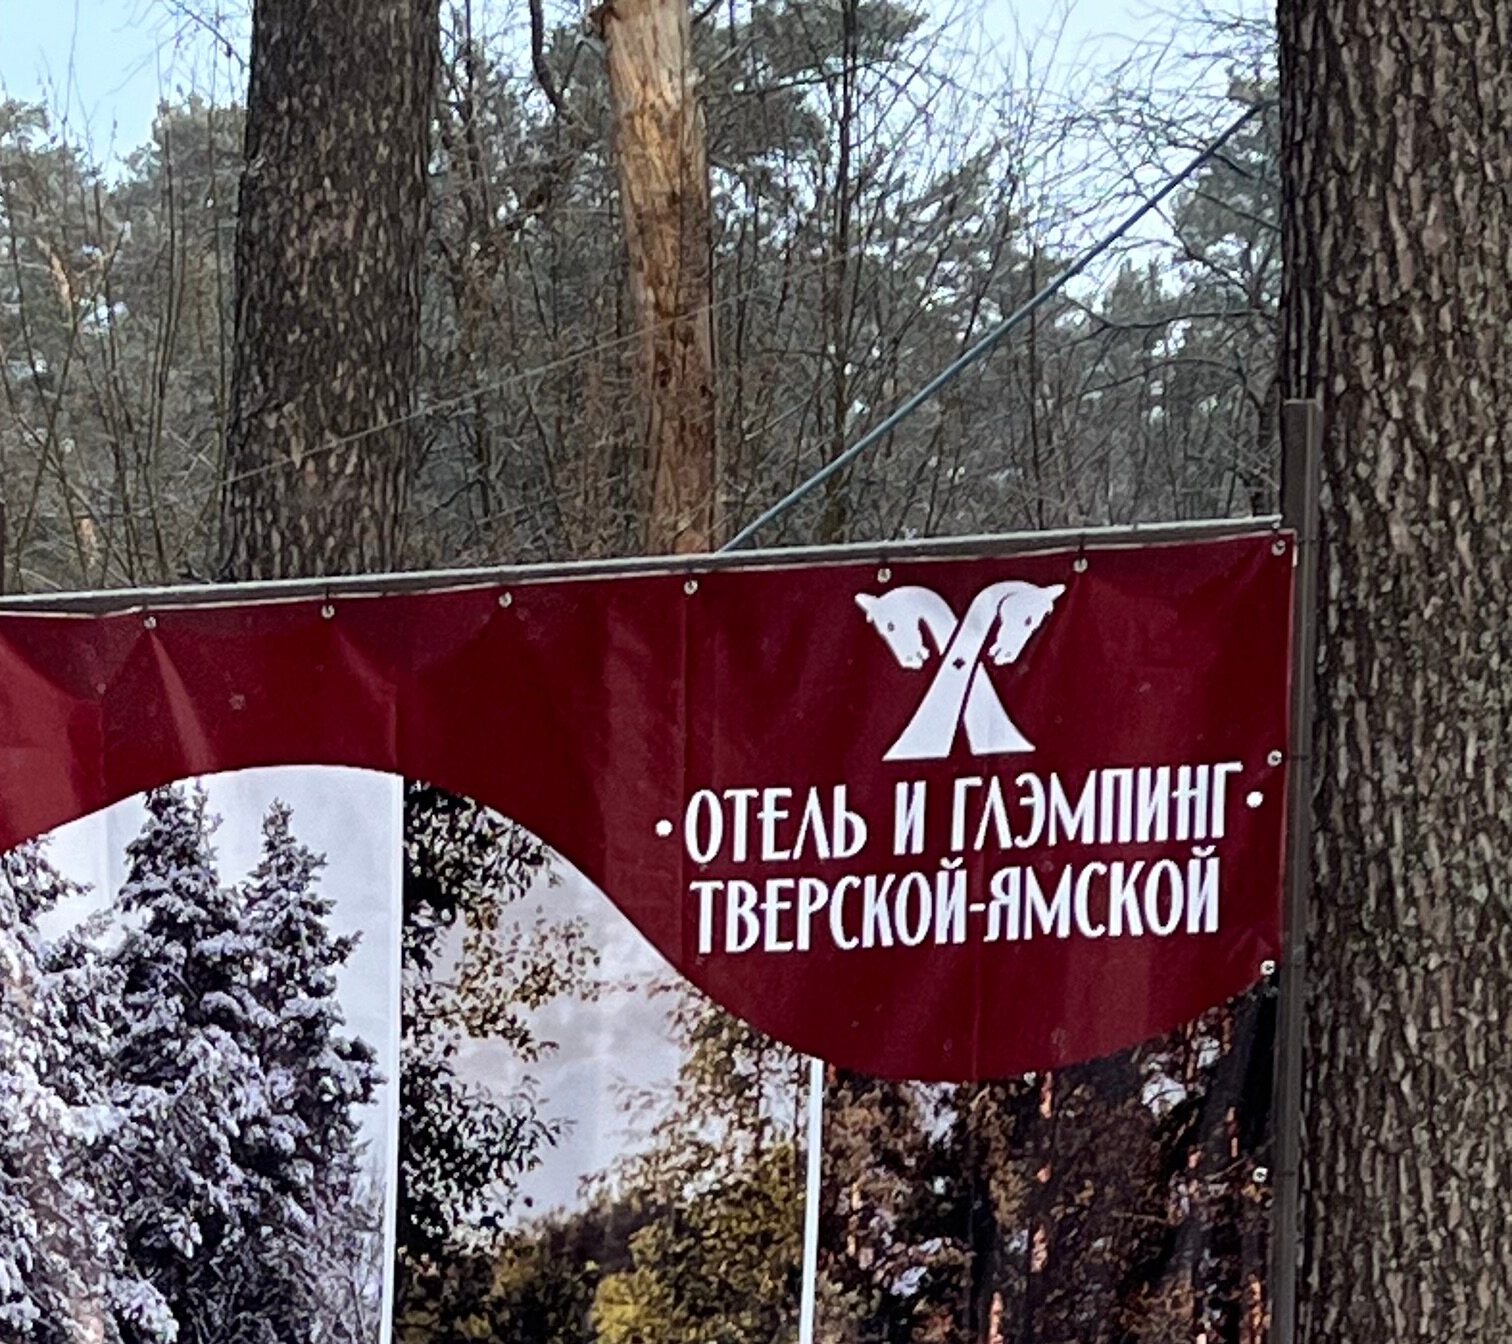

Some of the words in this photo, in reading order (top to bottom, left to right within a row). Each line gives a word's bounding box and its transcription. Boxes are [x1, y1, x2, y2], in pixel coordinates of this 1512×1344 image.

[685, 784, 867, 864] ОТЕЛЬ
[892, 780, 927, 856] И
[950, 762, 1244, 853] ГЛЭМПИНГ
[689, 845, 1221, 954] ТВЕРСКОЙ-ЯМСКОЙ
